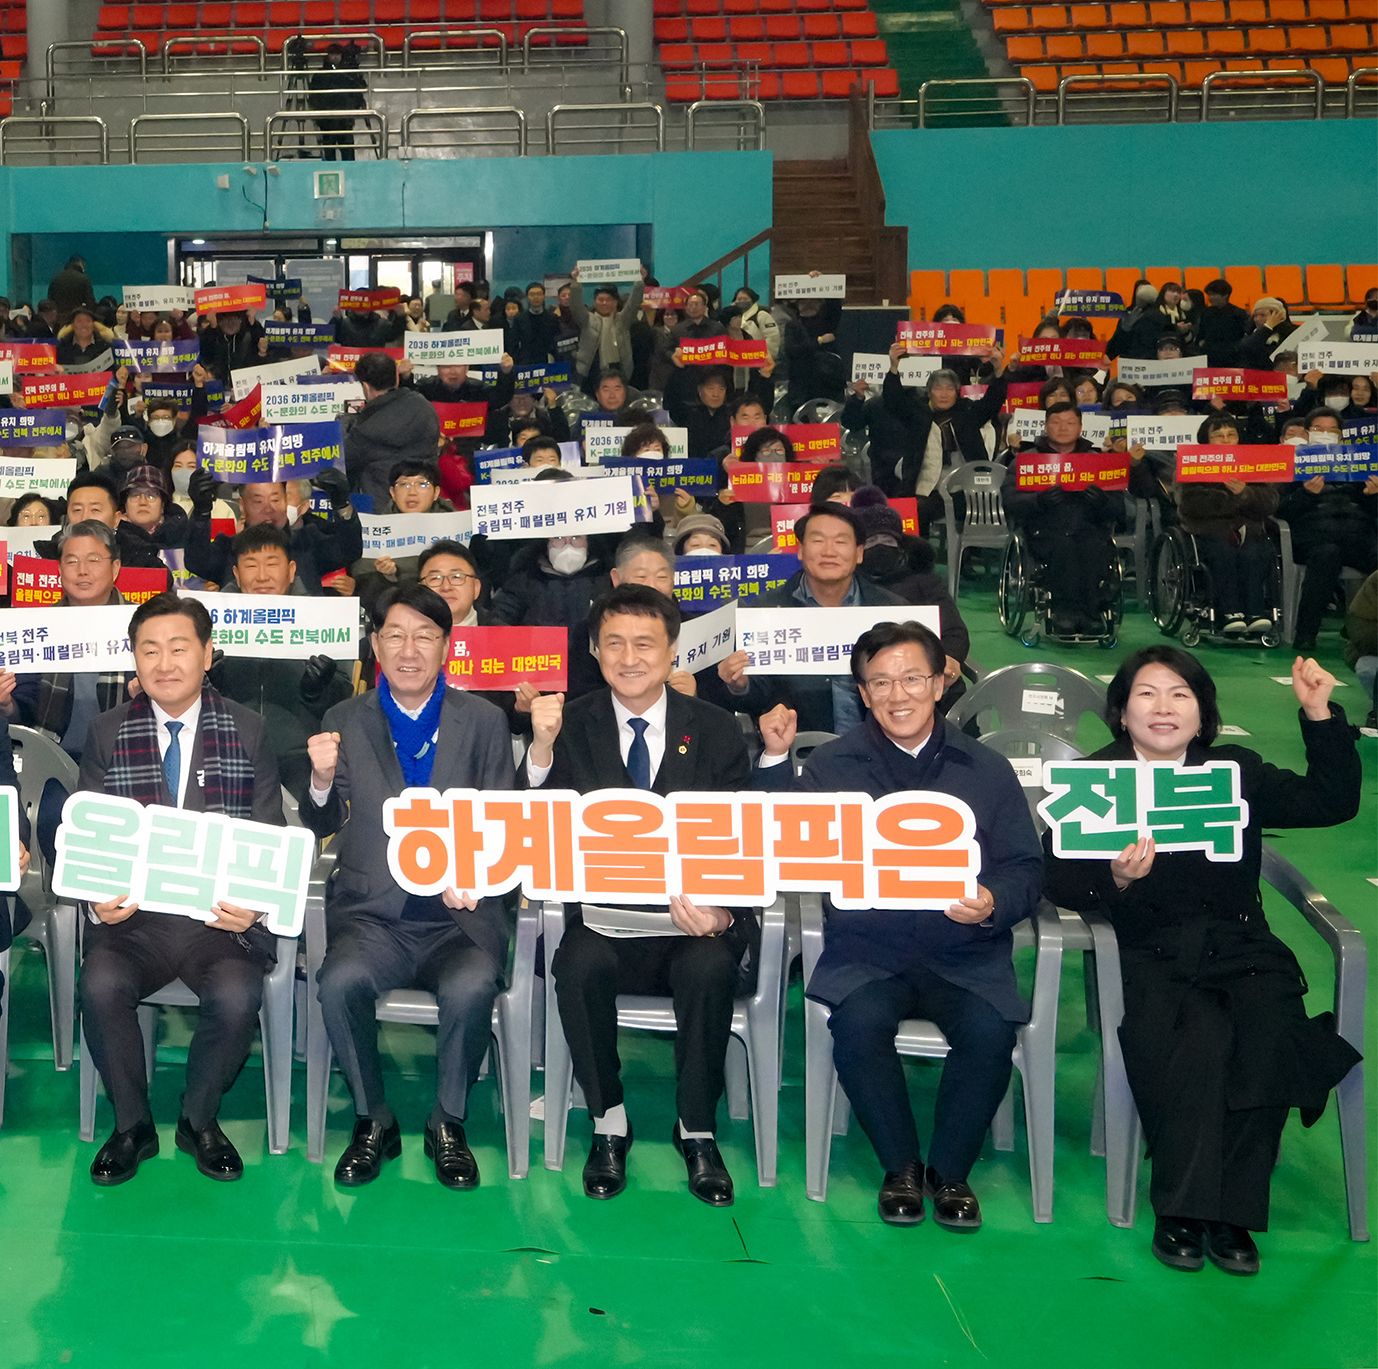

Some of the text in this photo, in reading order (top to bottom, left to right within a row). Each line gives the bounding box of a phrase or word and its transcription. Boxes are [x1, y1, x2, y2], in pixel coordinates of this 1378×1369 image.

[203, 433, 303, 456] 하계올림픽 희망
[201, 444, 340, 474] K-문화의 수도 전주에서
[1294, 452, 1370, 463] 하계올림픽 유치 희망
[1181, 462, 1286, 475] 올림픽으로 하나 되는 대한민국
[1295, 463, 1367, 474] K-문화의 수도 전북
[476, 500, 525, 518] 전북 전주
[573, 505, 598, 522] 유치
[604, 500, 628, 517] 기원
[223, 608, 296, 626] 하계올림픽
[21, 626, 49, 645] 전주
[254, 626, 351, 646] 수도 전북에서
[685, 626, 732, 662] 유치 기원
[742, 627, 802, 647] 전북 전주
[449, 653, 561, 676] 하나 되는 대한민국
[1047, 765, 1241, 854] 전북
[392, 799, 970, 900] 하계올림픽은
[61, 800, 305, 927] 올림픽
